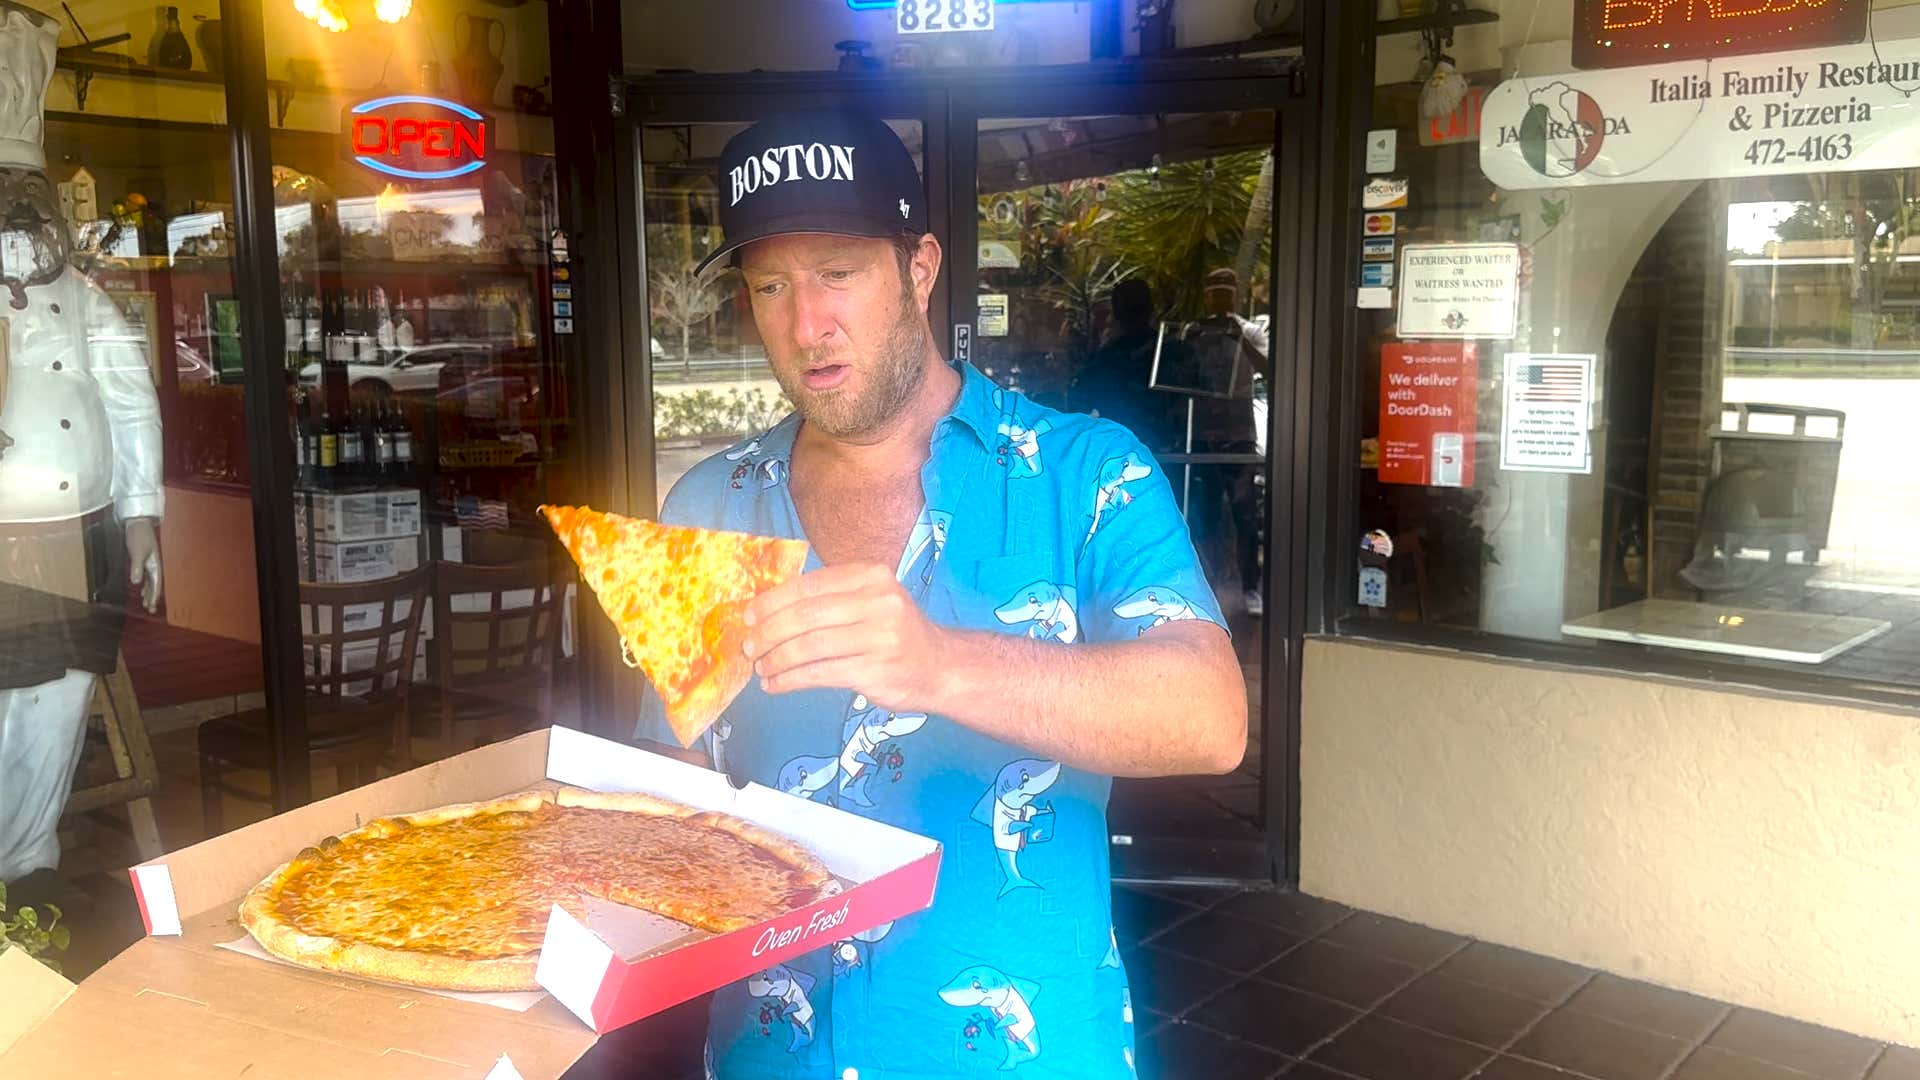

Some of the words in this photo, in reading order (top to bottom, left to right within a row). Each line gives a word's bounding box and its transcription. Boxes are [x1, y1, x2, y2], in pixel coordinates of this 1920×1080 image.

[900, 0, 990, 31] 8283
[1649, 74, 1712, 104] Italia
[1721, 65, 1809, 98] Family
[1728, 105, 1753, 132] &
[1763, 96, 1872, 130] Pizzeria
[352, 115, 486, 159] OPEN
[1497, 116, 1632, 148] JARADA
[1744, 133, 1853, 166] 472-4163
[729, 142, 856, 207] BOSTON
[1409, 255, 1472, 266] EXPERIENCED
[1475, 254, 1512, 265] WAITER
[1415, 279, 1460, 288] WAITRESS
[1462, 279, 1503, 288] WANTED
[958, 328, 968, 360] PUL
[1387, 389, 1416, 400] with
[1388, 373, 1411, 386] We
[1413, 373, 1458, 386] deliver
[1387, 403, 1453, 416] DoorDash
[752, 926, 802, 957] Oven
[803, 899, 851, 939] Fresh
